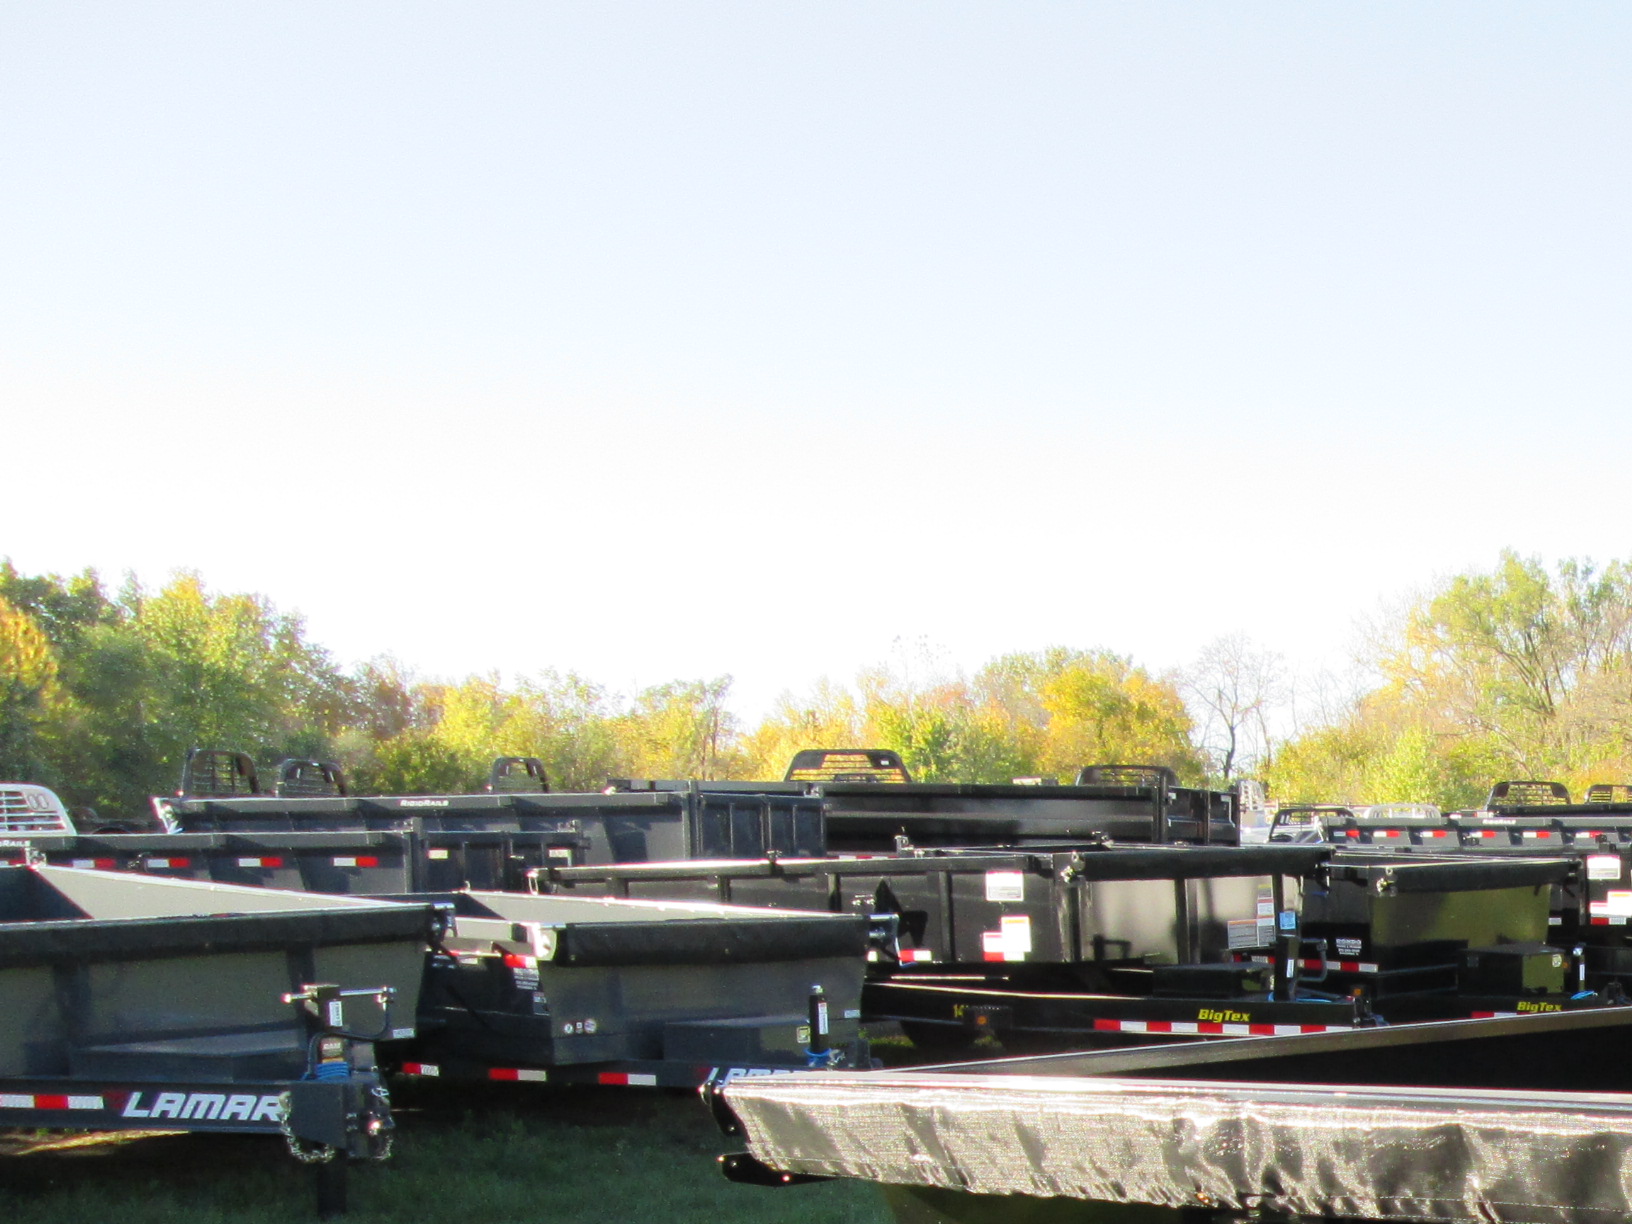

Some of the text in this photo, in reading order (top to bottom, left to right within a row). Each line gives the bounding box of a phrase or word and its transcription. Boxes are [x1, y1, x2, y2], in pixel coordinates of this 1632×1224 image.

[1517, 1002, 1563, 1013] BigTex
[1198, 1008, 1250, 1023] BigTex
[121, 1091, 283, 1122] LAMAR
